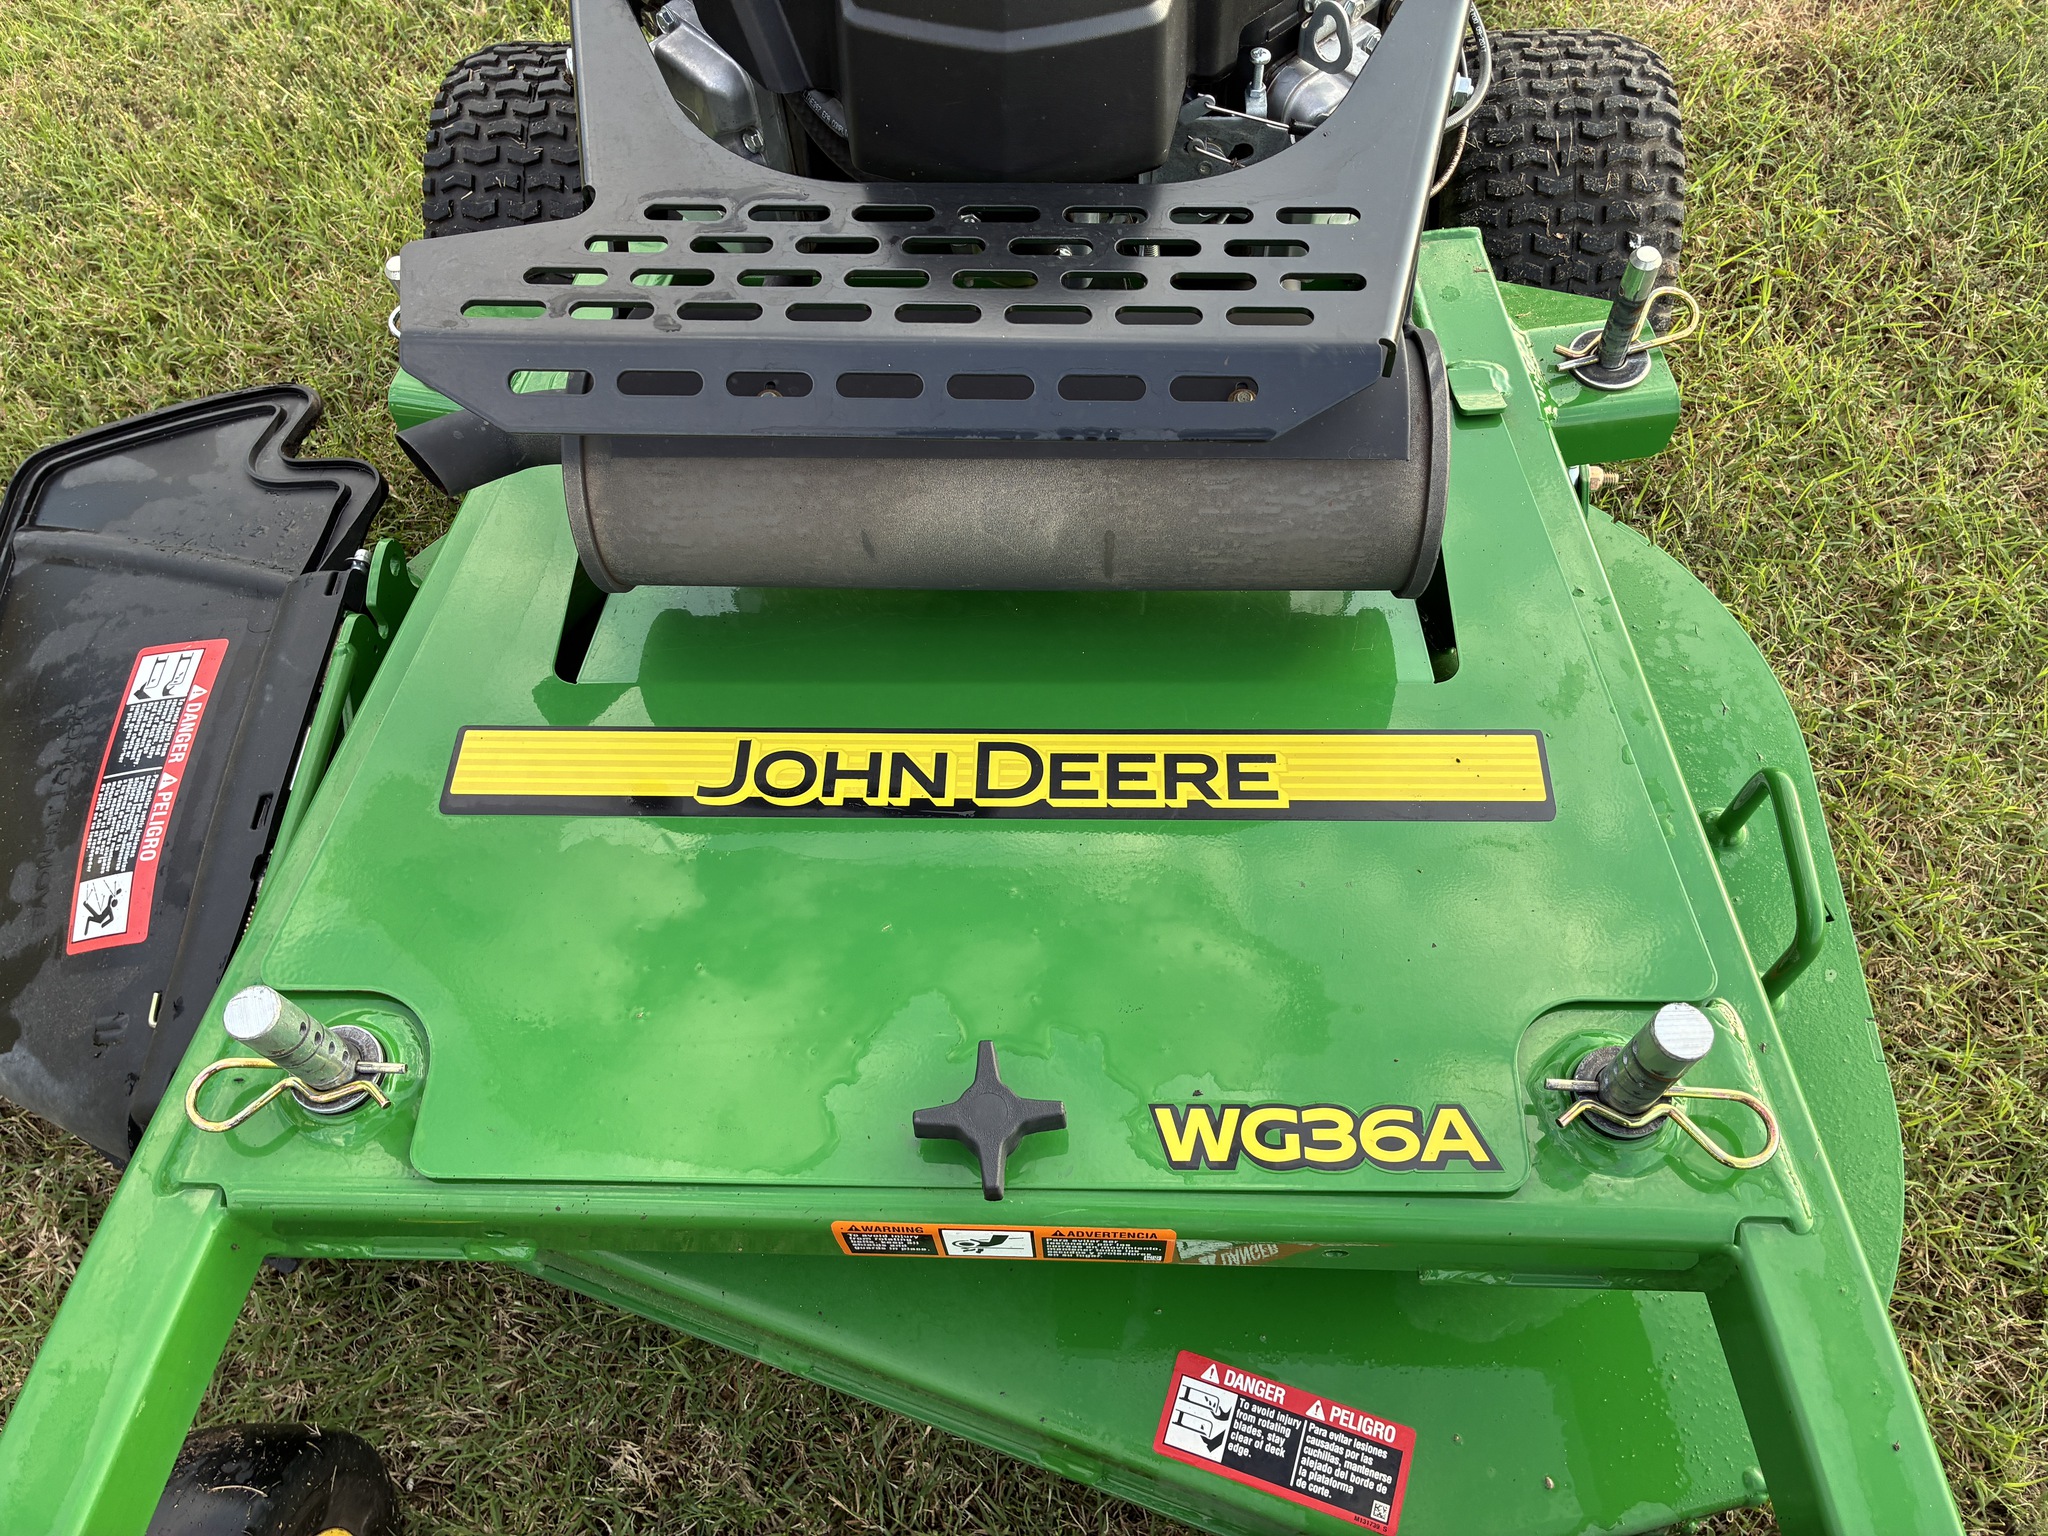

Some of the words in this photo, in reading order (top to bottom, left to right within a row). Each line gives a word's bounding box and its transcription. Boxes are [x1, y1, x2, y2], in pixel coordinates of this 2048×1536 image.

[167, 702, 202, 763] DANGER
[696, 739, 947, 800] JOHN
[975, 741, 1278, 801] DEERE
[139, 790, 172, 861] PELIGRO
[1153, 1106, 1492, 1166] WG36A
[1066, 1230, 1157, 1239] ADVERTENCIA
[1222, 1368, 1287, 1405] DANGER
[1236, 1408, 1257, 1425] from
[1257, 1416, 1292, 1438] rotating
[1238, 1397, 1251, 1411] To
[1251, 1401, 1276, 1419] avoid
[1276, 1410, 1302, 1430] injury
[1330, 1407, 1397, 1442] PELIGRO
[1227, 1441, 1253, 1459] edge.
[1230, 1430, 1251, 1446] clear
[1251, 1436, 1264, 1450] of
[1264, 1441, 1286, 1457] deck
[1233, 1419, 1266, 1440] blades,
[1266, 1431, 1286, 1448] stay
[1305, 1433, 1345, 1455] causadas
[1344, 1449, 1360, 1462] por
[1360, 1452, 1374, 1465] las
[1308, 1422, 1328, 1437] Para
[1328, 1430, 1352, 1446] evitar
[1353, 1438, 1389, 1459] lesiones
[1298, 1465, 1308, 1477] la
[1308, 1469, 1355, 1494] plataforma
[1300, 1455, 1333, 1475] alejado
[1334, 1467, 1349, 1480] del
[1349, 1472, 1375, 1489] borde
[1376, 1481, 1388, 1494] de
[1303, 1444, 1343, 1467] cuchillas,
[1343, 1459, 1393, 1484] mantenerse
[1295, 1476, 1308, 1489] de
[1308, 1482, 1333, 1498] corte.
